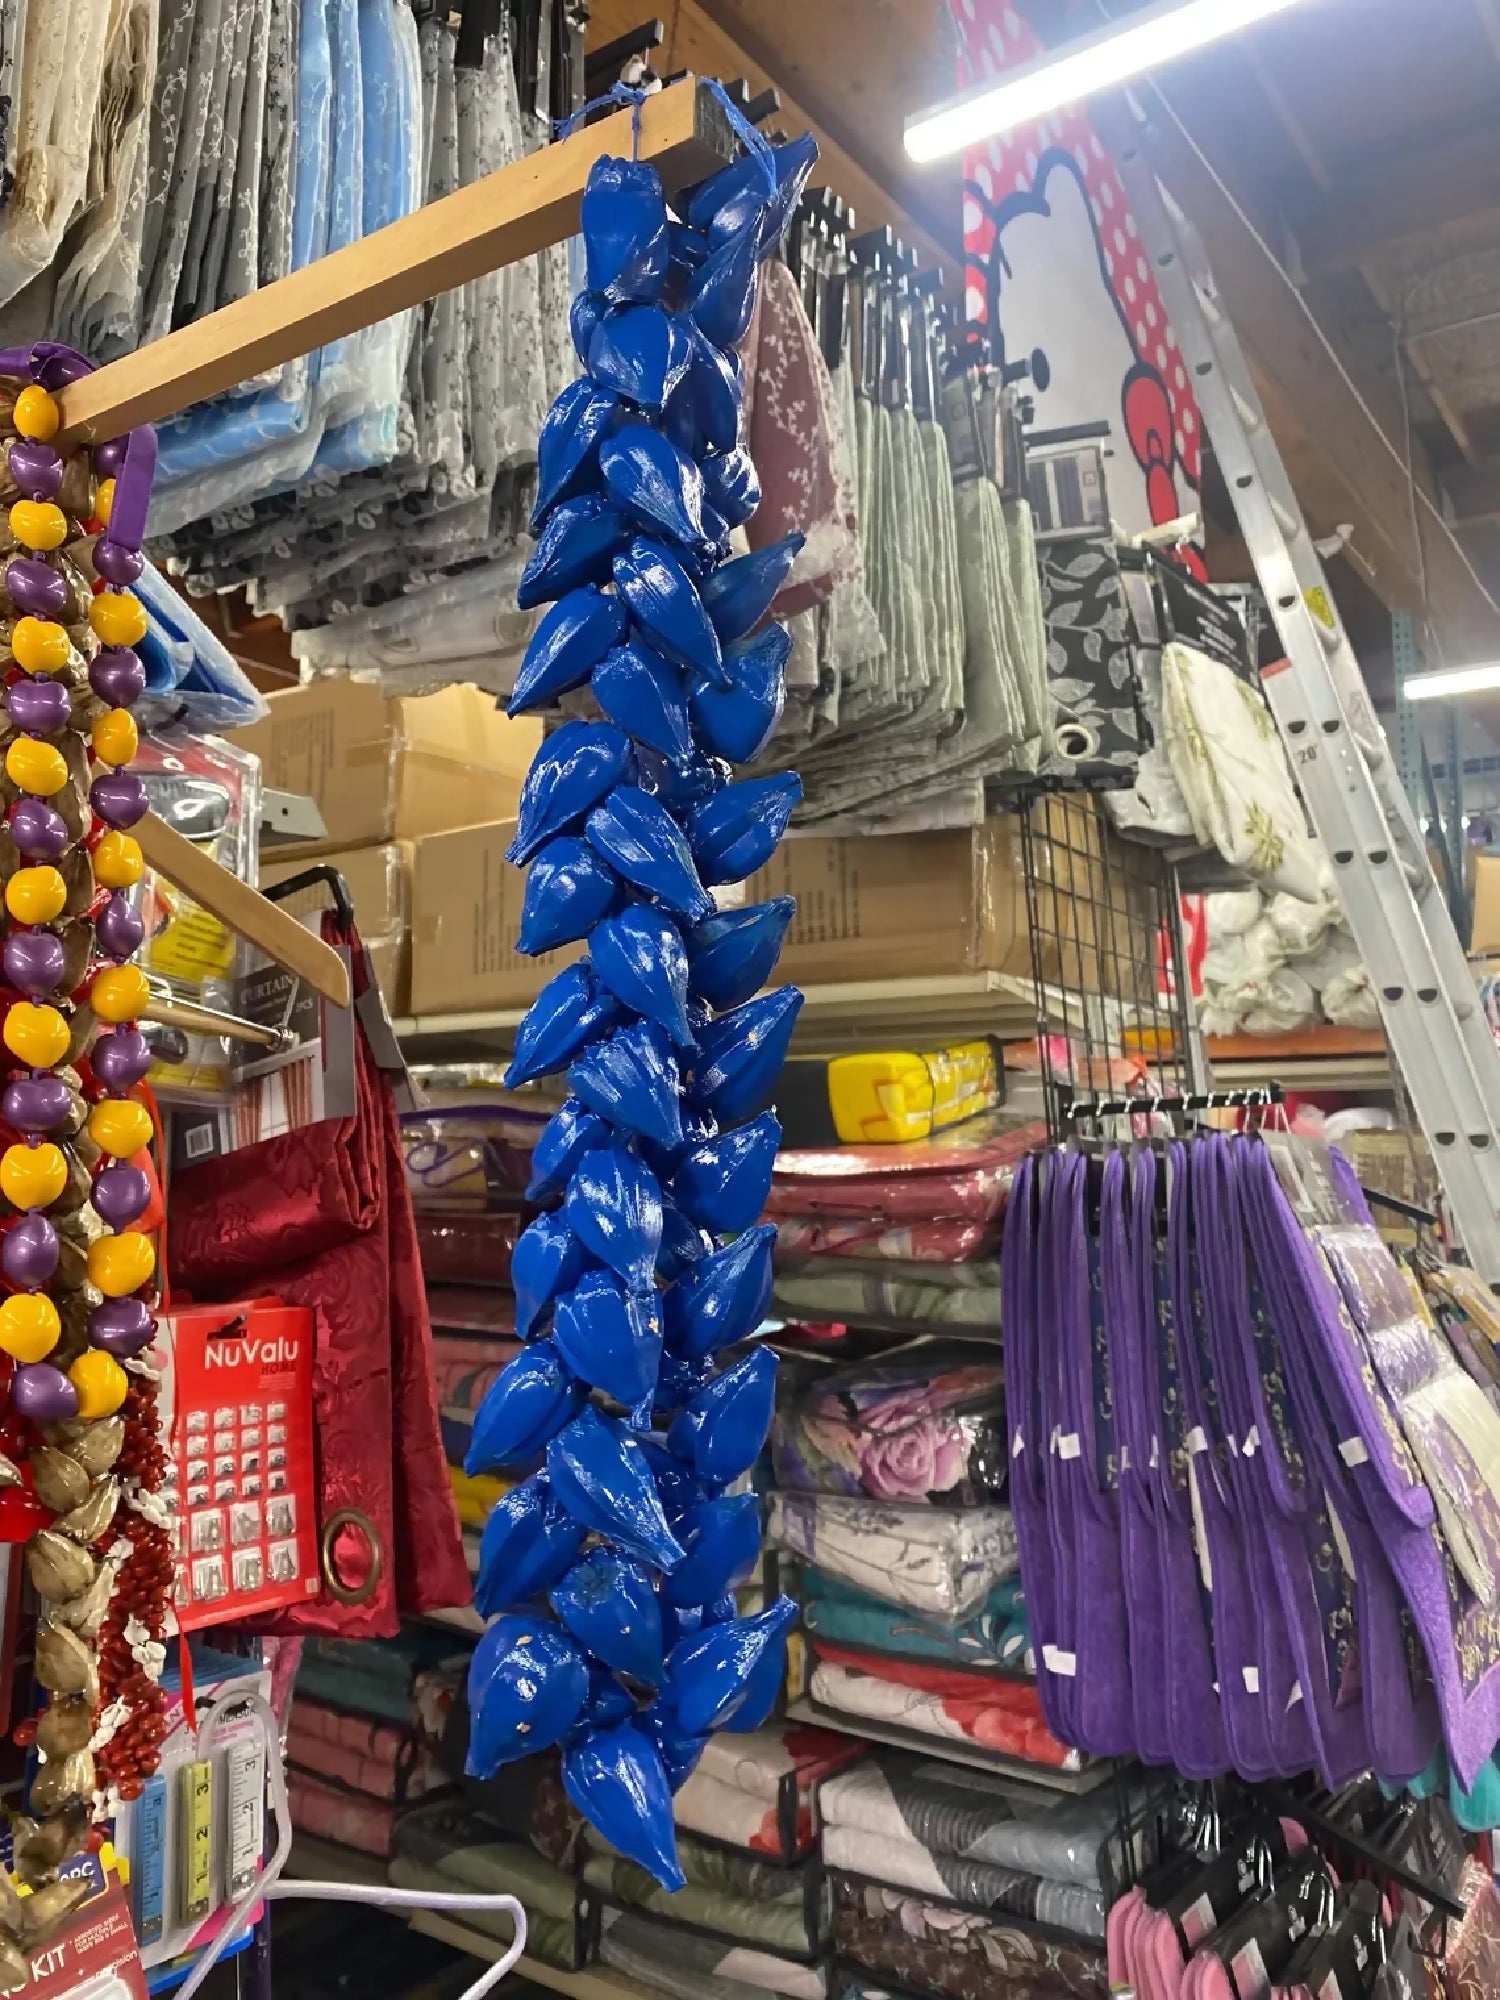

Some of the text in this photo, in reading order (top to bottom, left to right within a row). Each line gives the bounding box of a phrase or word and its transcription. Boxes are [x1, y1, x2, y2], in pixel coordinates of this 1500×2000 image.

[204, 1336, 299, 1370] NuValu
[261, 1361, 297, 1375] HOME
[196, 1783, 209, 1797] 3
[196, 1827, 208, 1841] 2
[30, 1942, 66, 1983] KIT
